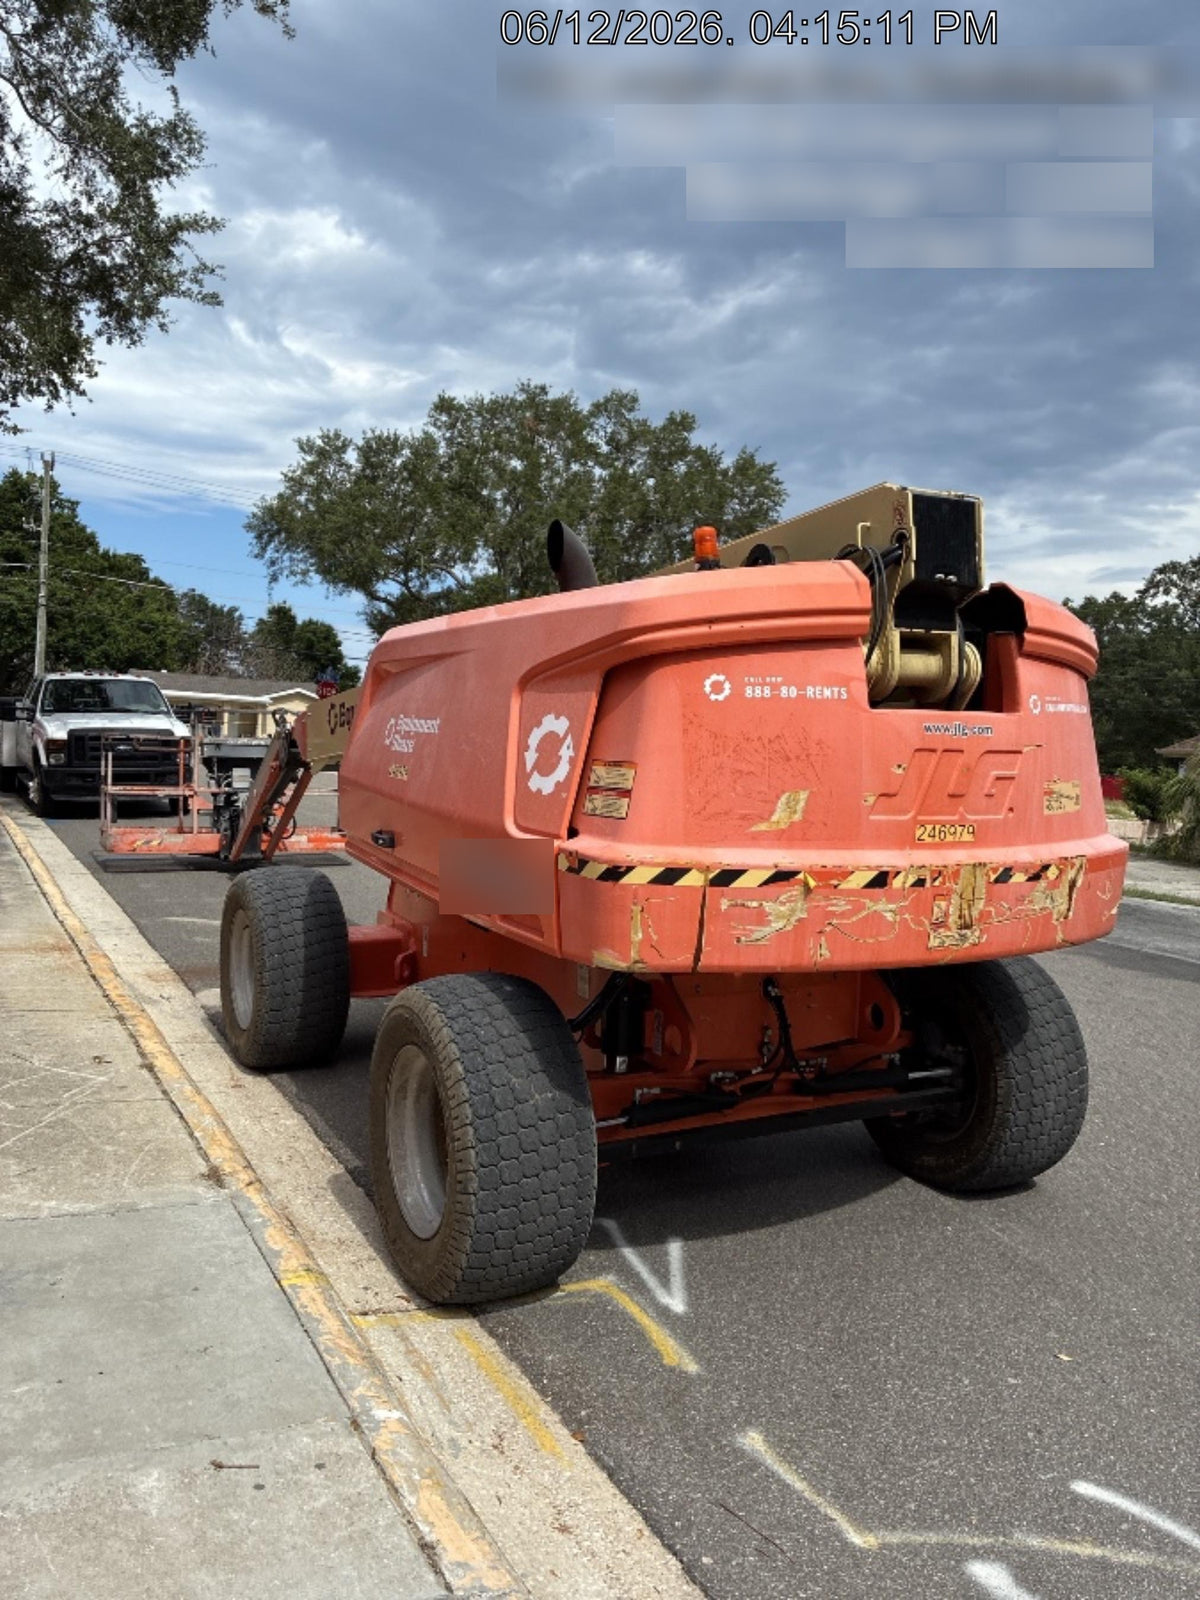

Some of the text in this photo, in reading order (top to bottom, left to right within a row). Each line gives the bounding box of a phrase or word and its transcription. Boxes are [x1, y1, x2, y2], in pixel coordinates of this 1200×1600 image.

[744, 685, 848, 700] 888-80-RENTS
[923, 722, 993, 737] www.jlg.com
[868, 747, 1024, 820] JLG
[916, 824, 976, 842] 246979
